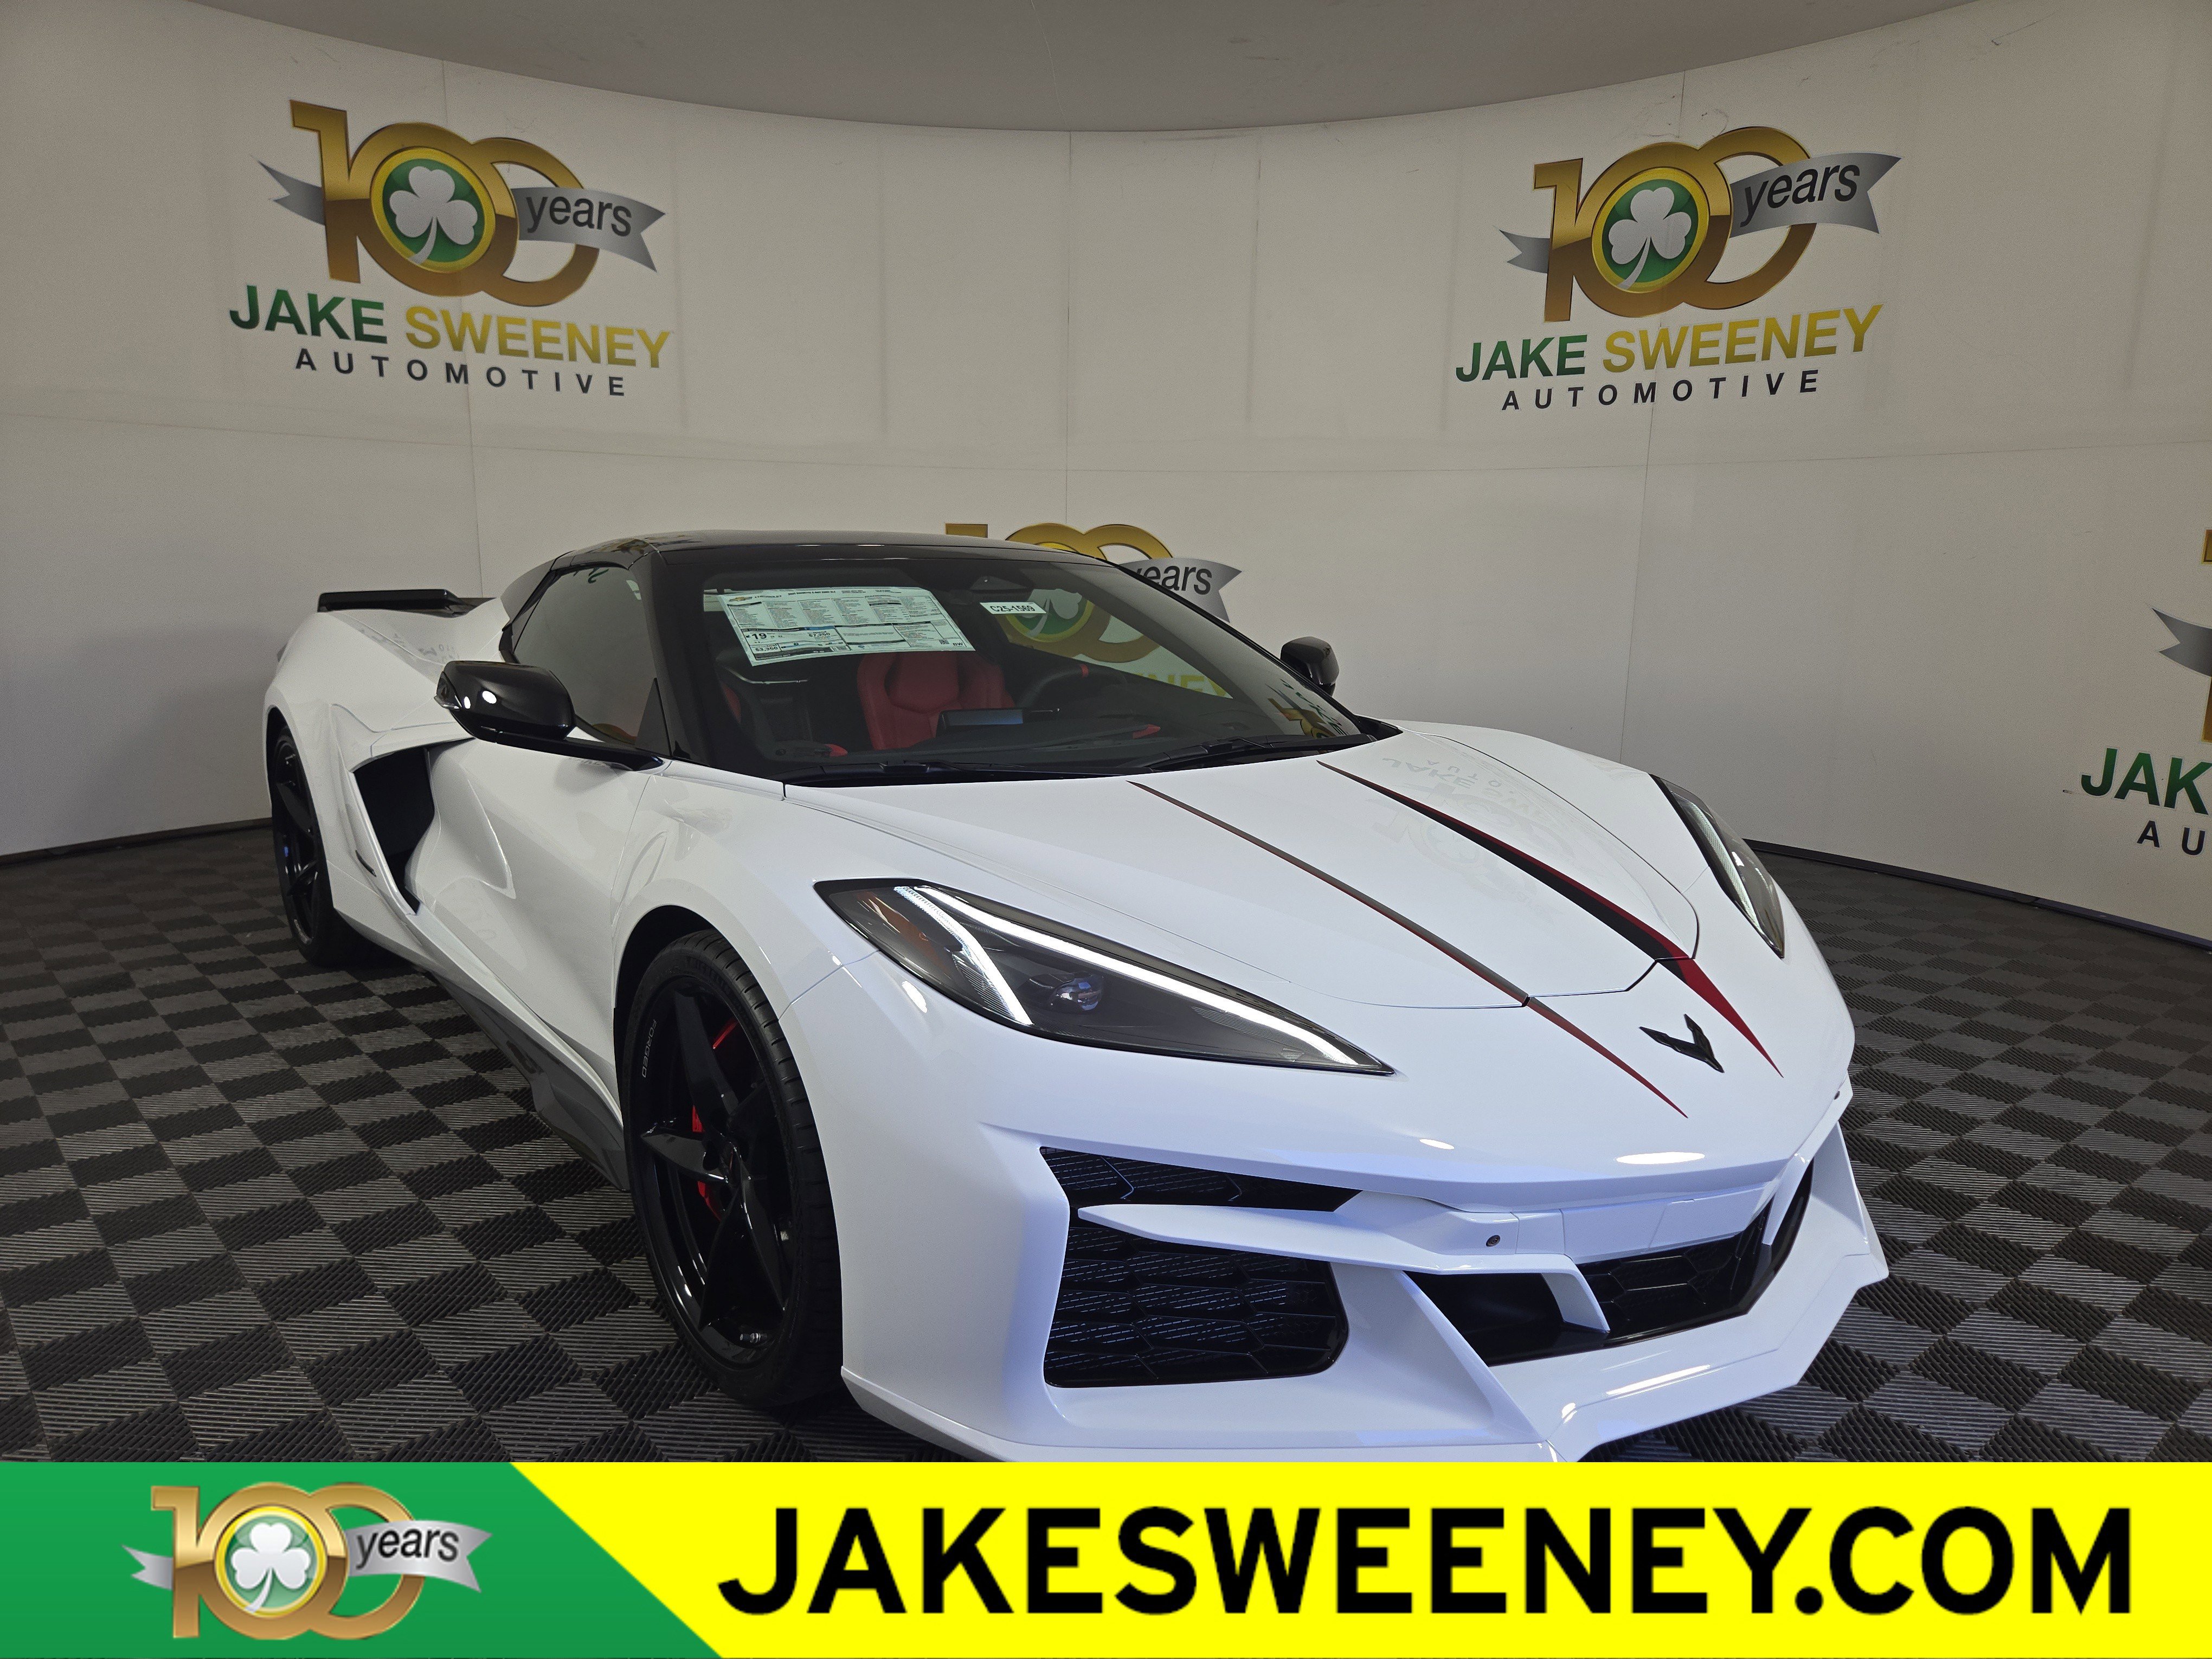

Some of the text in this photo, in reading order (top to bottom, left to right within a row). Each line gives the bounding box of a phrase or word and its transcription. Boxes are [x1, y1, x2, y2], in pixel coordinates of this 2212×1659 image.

[290, 99, 600, 307] 100
[524, 195, 632, 237] years
[1533, 126, 1817, 323] 100
[1739, 164, 1860, 227] years
[229, 285, 670, 368] JAKE SWEENEY
[1456, 304, 1884, 382] JAKE SWEENEY
[295, 348, 625, 396] AUTOMOTIVE
[1501, 369, 1819, 411] AUTOMOTIVE
[2137, 820, 2205, 856] AU
[642, 1019, 657, 1078] FORGED
